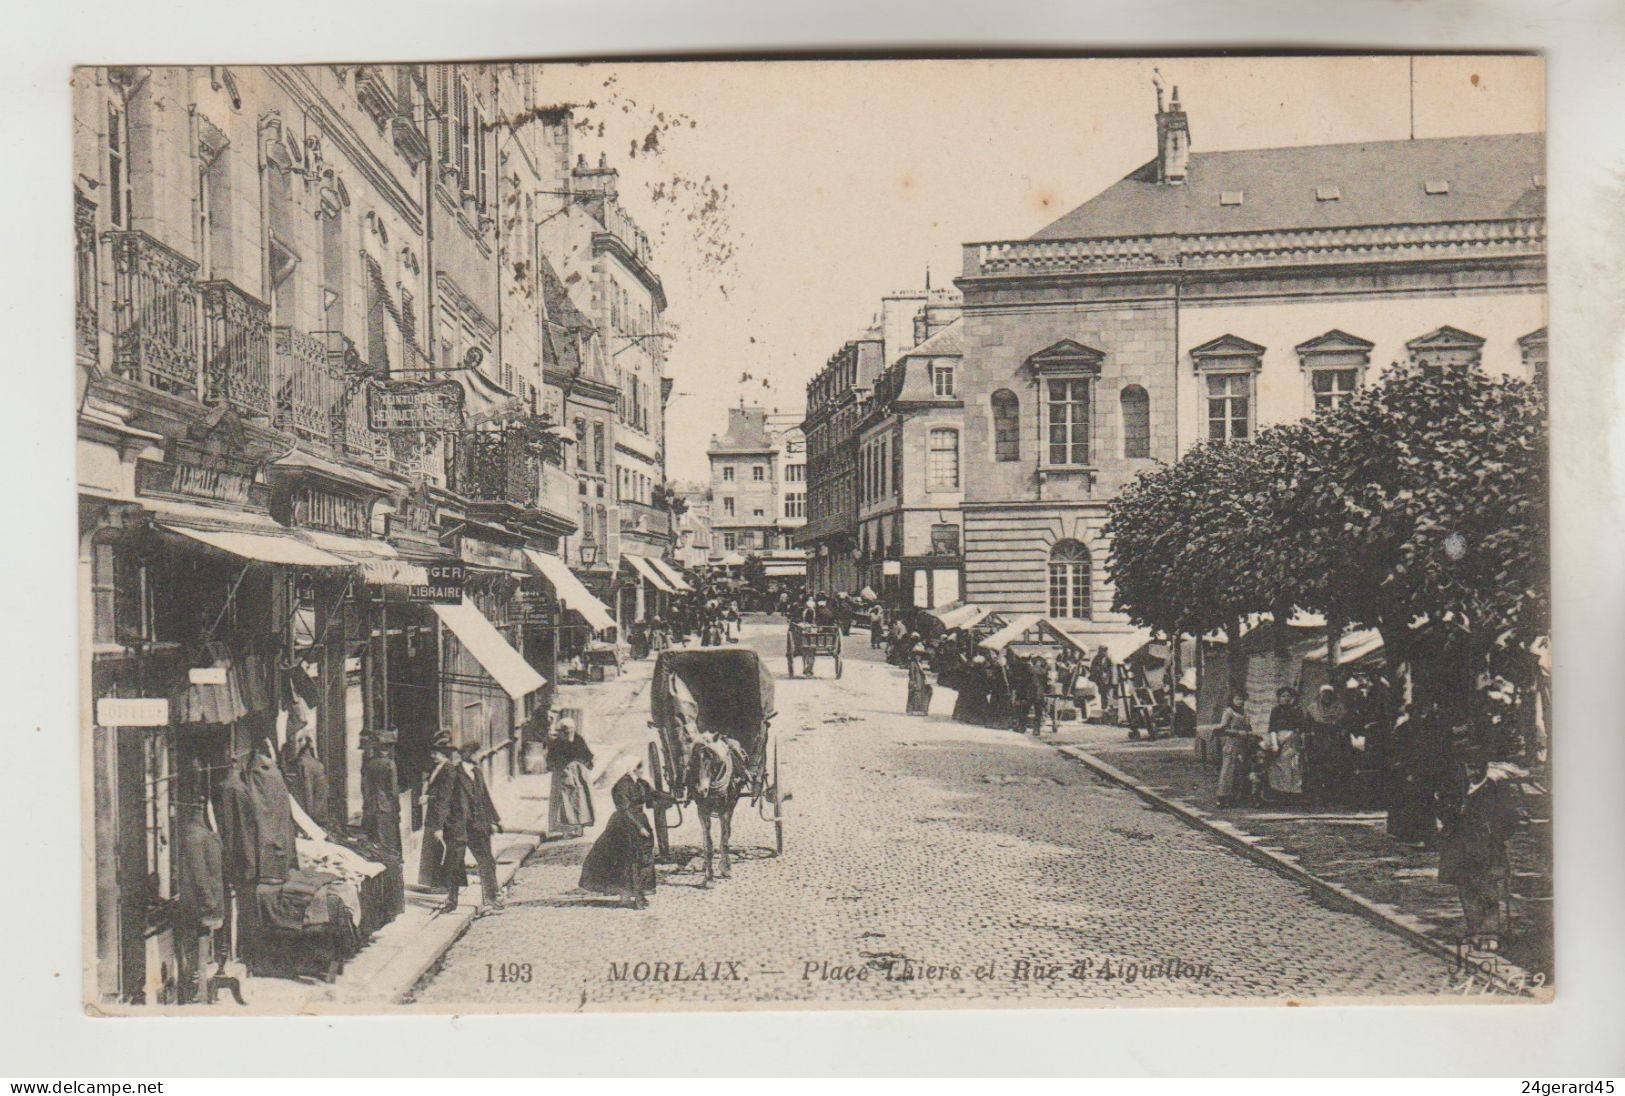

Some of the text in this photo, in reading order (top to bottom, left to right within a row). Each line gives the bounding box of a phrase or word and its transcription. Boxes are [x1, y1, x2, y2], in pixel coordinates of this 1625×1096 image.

[485, 962, 533, 983] 1493
[606, 961, 749, 982] MORLAIX.
[801, 960, 869, 981] Place
[884, 957, 962, 981] Thiers
[974, 959, 996, 981] et
[1012, 958, 1061, 981] Rue
